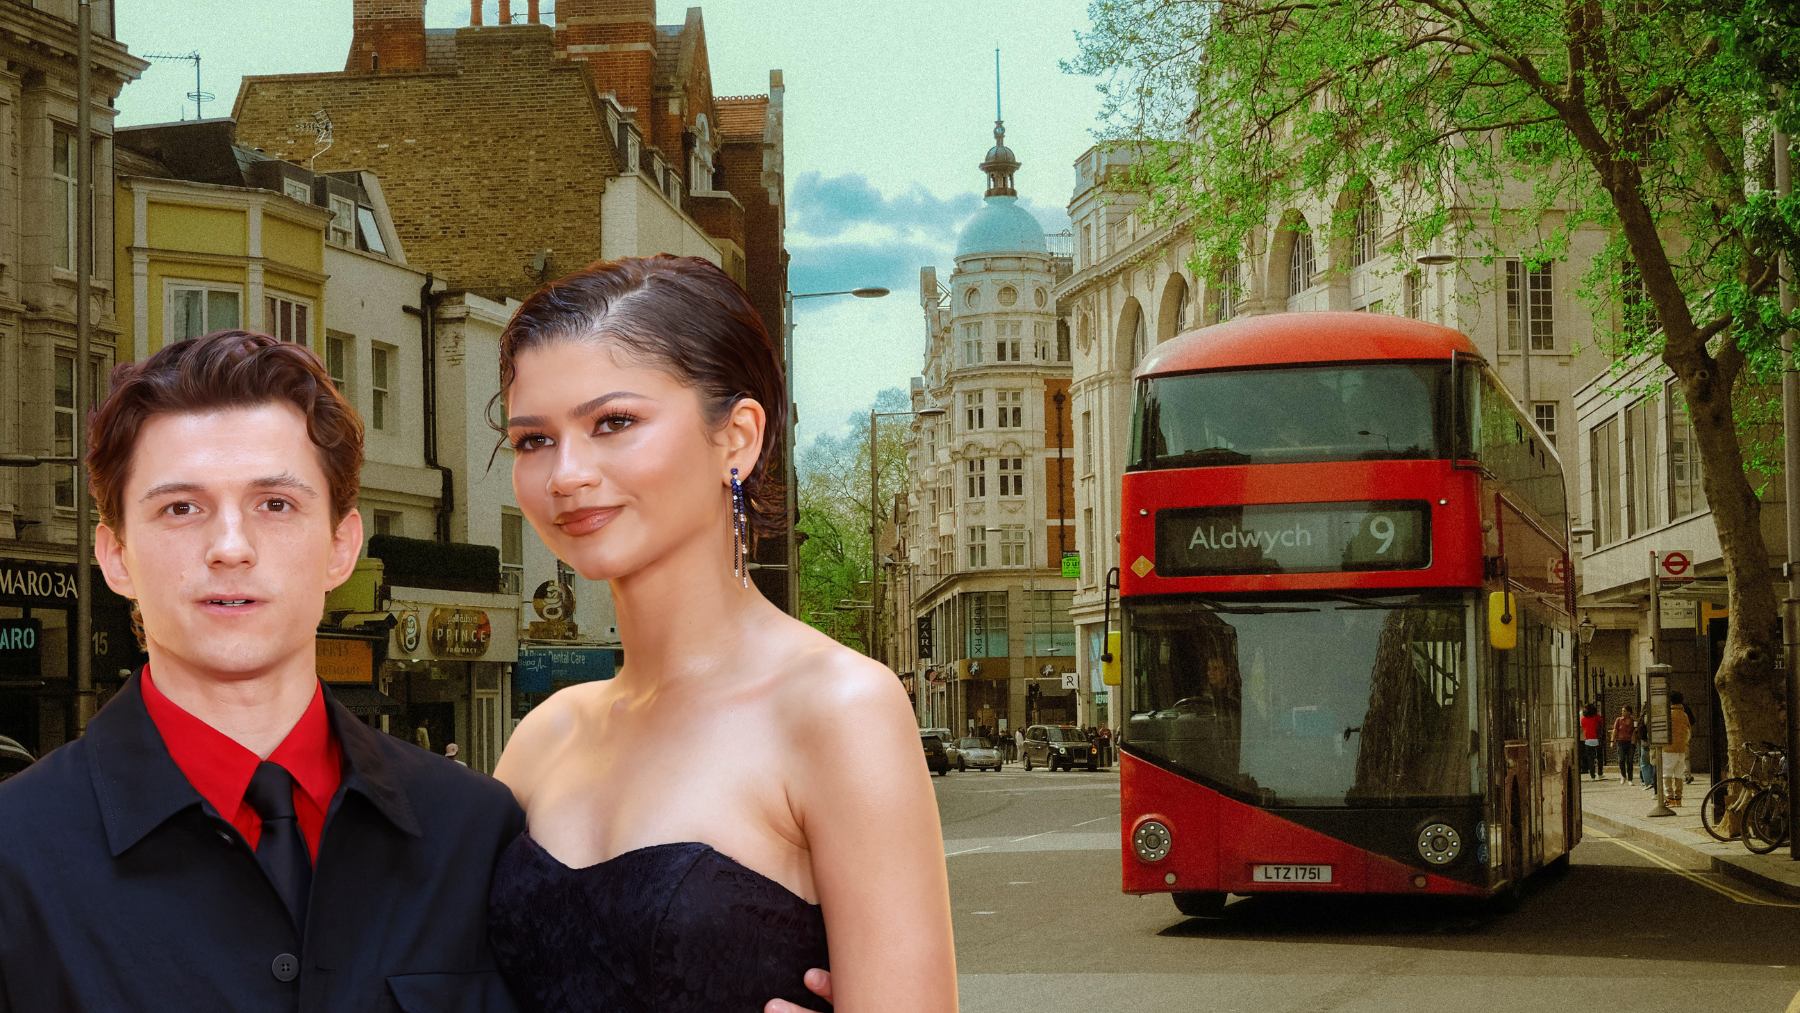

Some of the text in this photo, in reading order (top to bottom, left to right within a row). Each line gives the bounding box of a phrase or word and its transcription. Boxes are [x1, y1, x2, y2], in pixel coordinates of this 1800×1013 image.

[1189, 515, 1395, 554] Aldwych 9
[92, 631, 108, 655] 15
[437, 628, 487, 643] PRINCE
[920, 621, 930, 654] ZARA
[974, 638, 982, 654] FIX
[548, 650, 570, 664] Dental
[570, 651, 586, 665] Care
[1264, 867, 1321, 880] LTZ 1751
